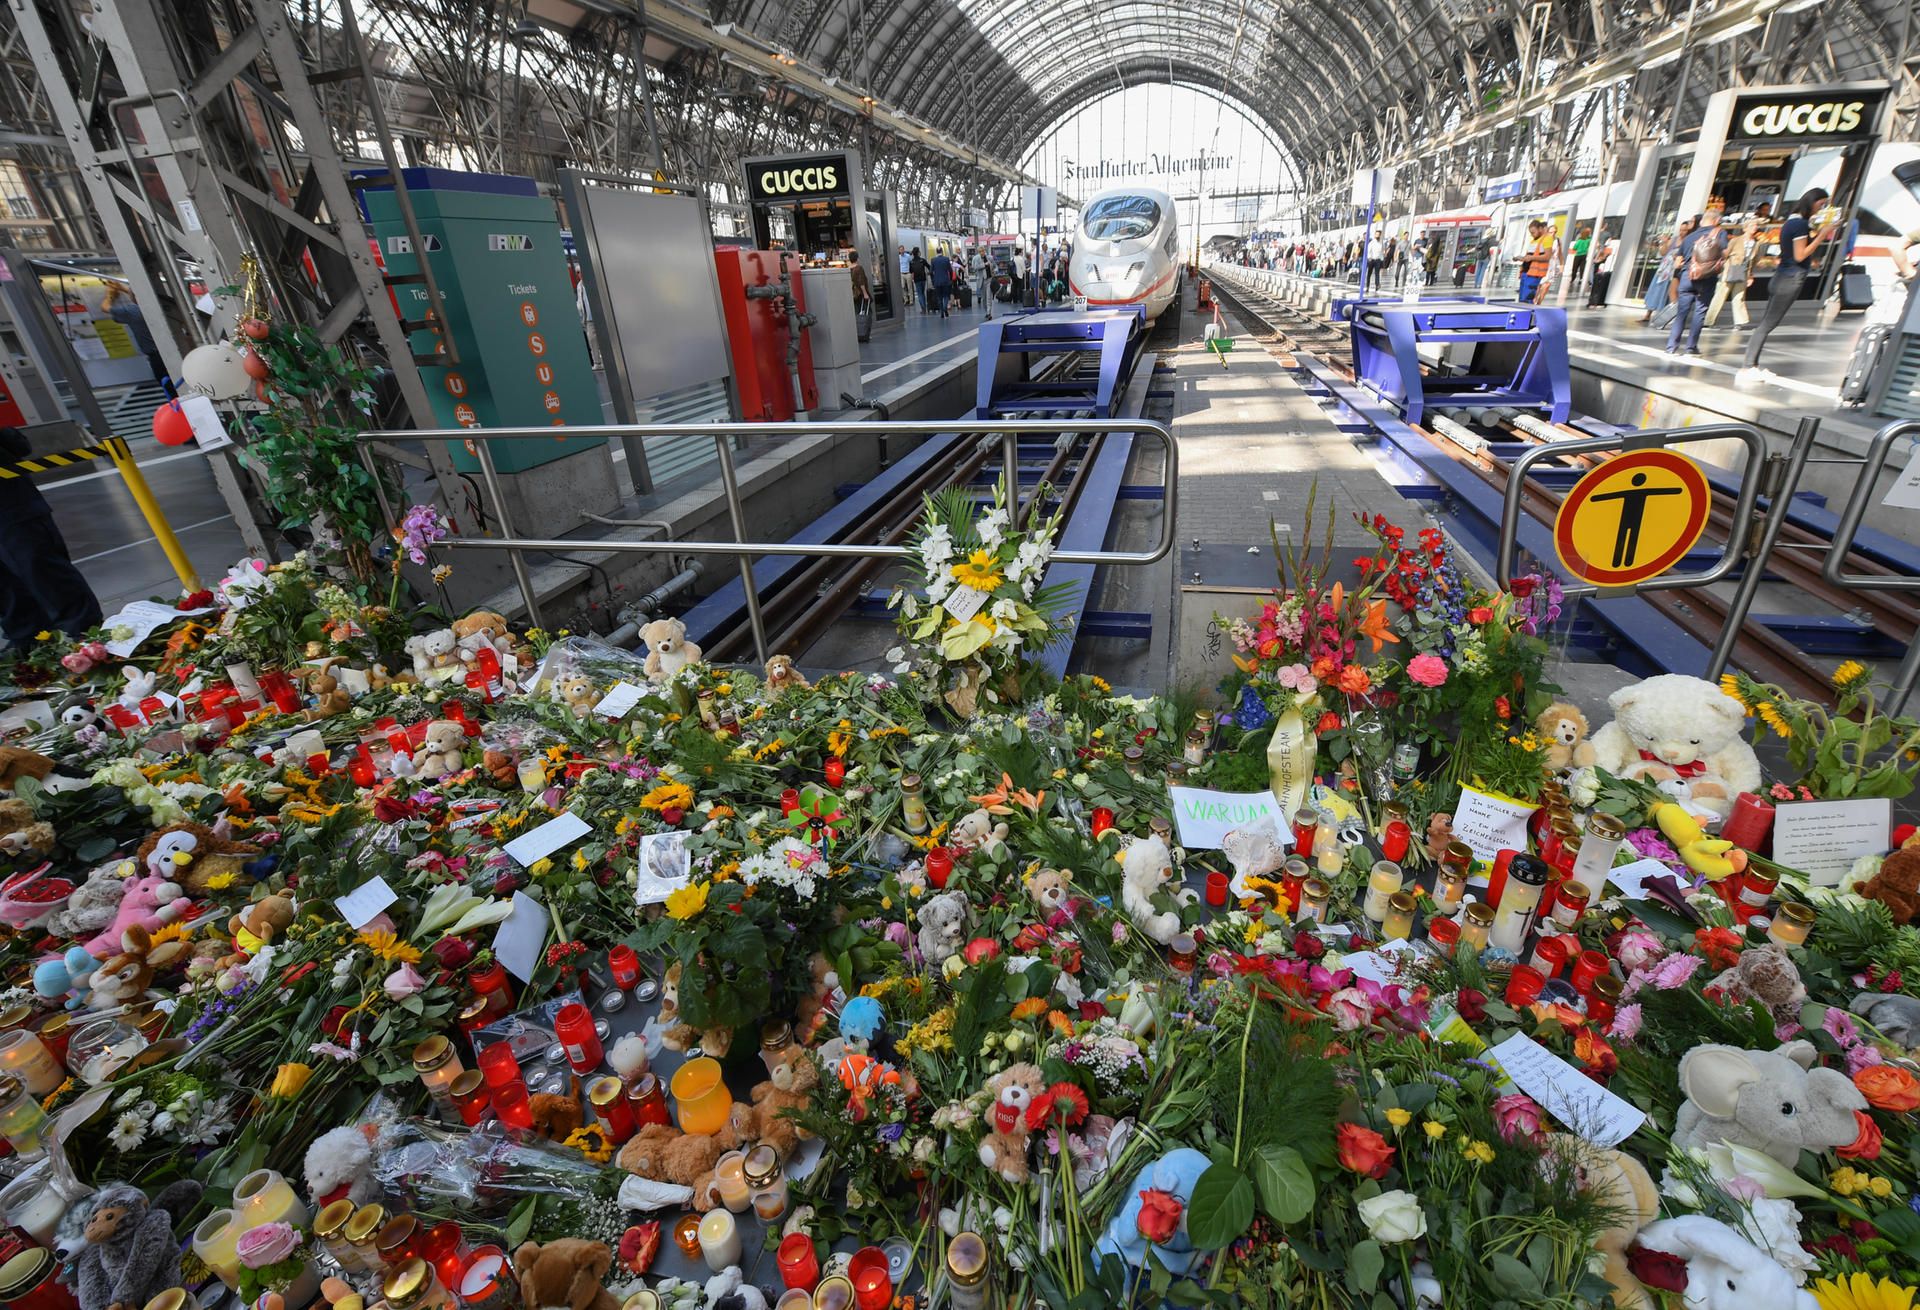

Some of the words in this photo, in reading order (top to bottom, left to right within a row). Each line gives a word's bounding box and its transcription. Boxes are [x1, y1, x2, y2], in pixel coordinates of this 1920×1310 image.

[1743, 102, 1865, 136] CUCCIS
[761, 166, 837, 194] CUCCIS
[496, 234, 531, 251] RMV
[410, 289, 447, 301] Tics
[508, 284, 538, 296] Tickets
[1074, 296, 1087, 305] 207
[538, 367, 551, 382] U
[449, 378, 464, 394] U
